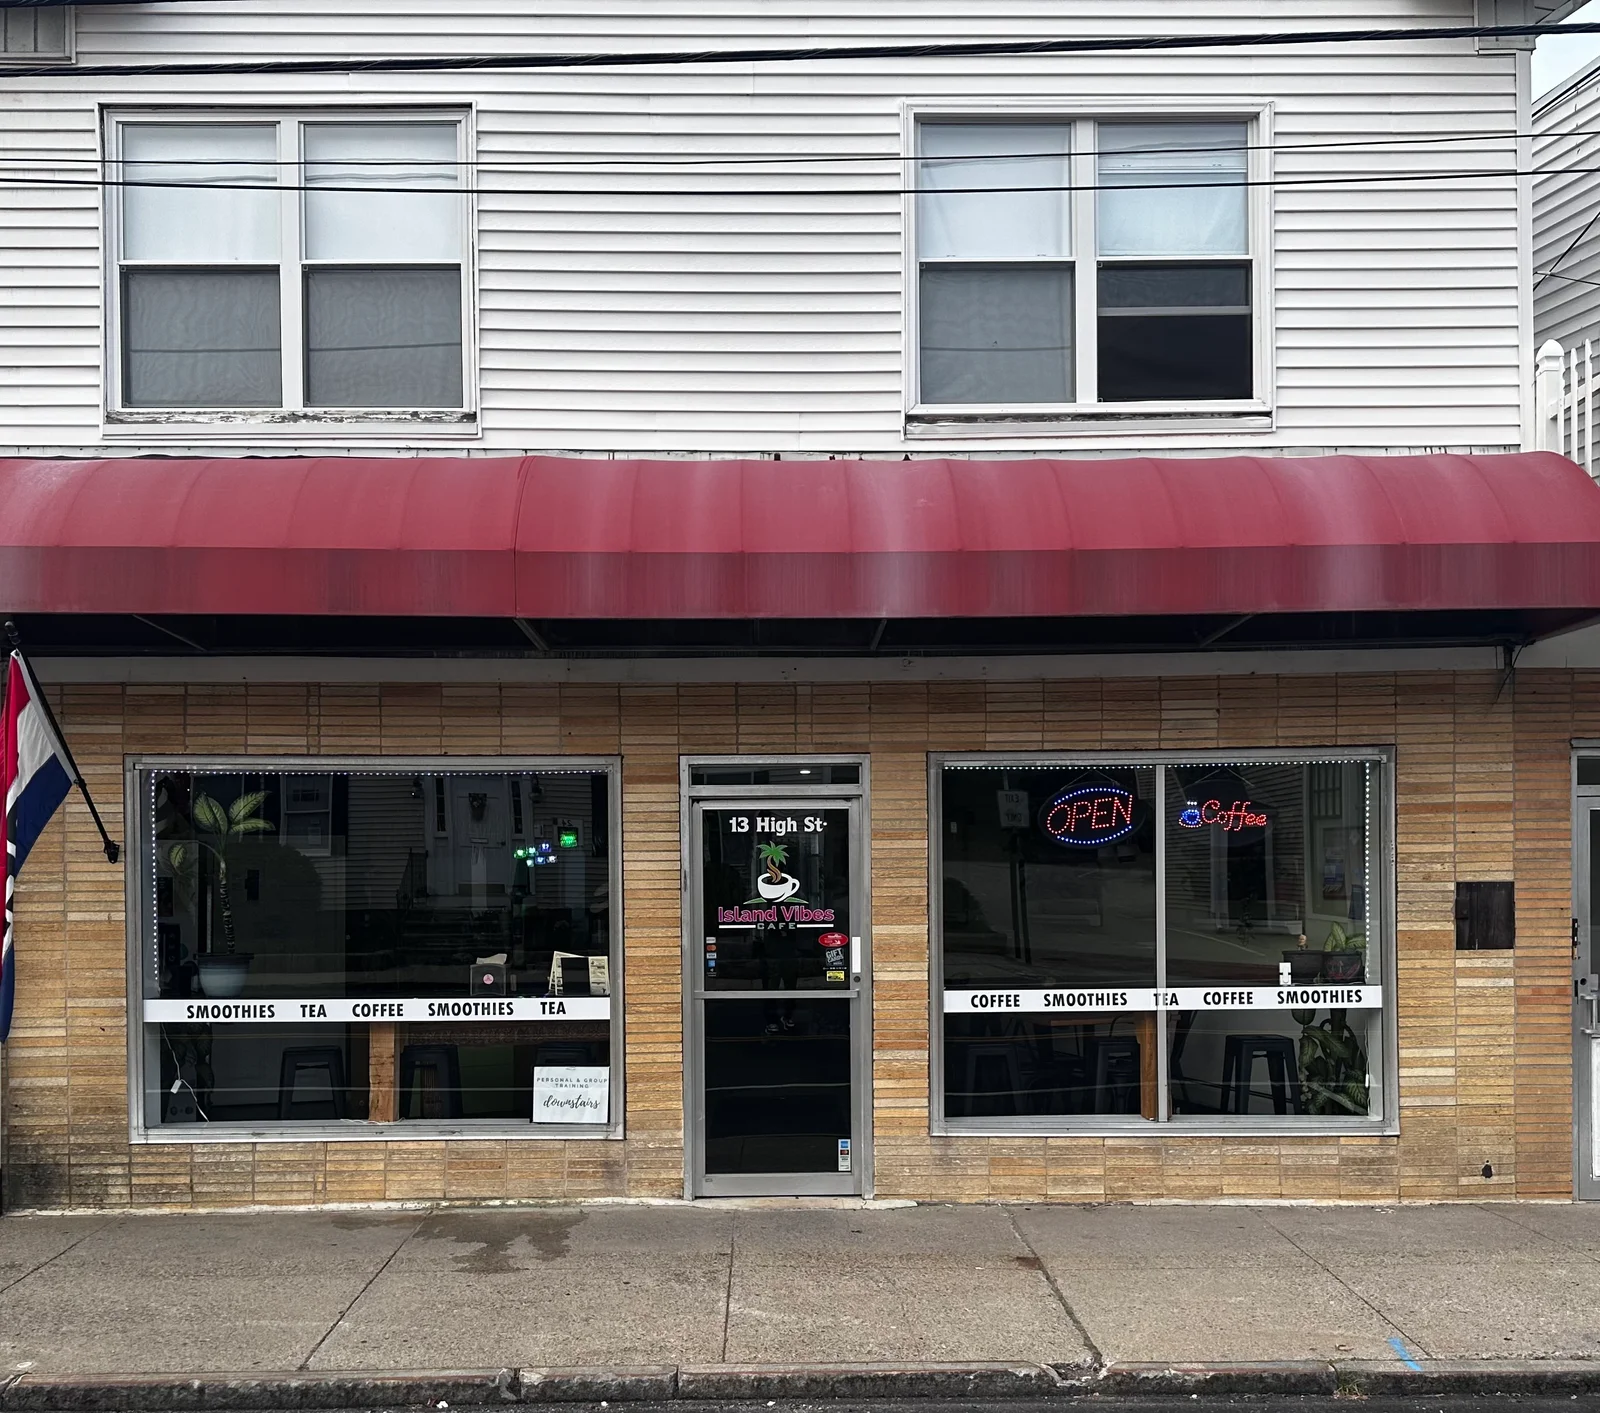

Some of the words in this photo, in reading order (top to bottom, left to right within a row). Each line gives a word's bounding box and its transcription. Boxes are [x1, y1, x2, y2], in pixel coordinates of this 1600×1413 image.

[1046, 794, 1133, 835] OPEN
[1201, 800, 1267, 831] Coffee
[729, 816, 749, 833] 13
[756, 816, 798, 836] High
[718, 906, 777, 922] Island
[780, 905, 835, 922] Vibes
[756, 922, 796, 930] CAFE
[825, 947, 843, 959] GIFT
[970, 994, 1021, 1008] COFFEE
[1043, 992, 1128, 1007] SMOOTHIES
[1153, 992, 1180, 1007] TEA
[1203, 991, 1254, 1006] COFFEE
[1277, 988, 1363, 1005] SMOOTHIES
[186, 1004, 276, 1019] SMOOTHIES
[299, 1004, 328, 1018] TEA
[352, 1003, 404, 1018] COFFEE
[427, 1001, 514, 1017] SMOOTHIES
[539, 1001, 567, 1015] TEA
[543, 1094, 600, 1110] downstairs
